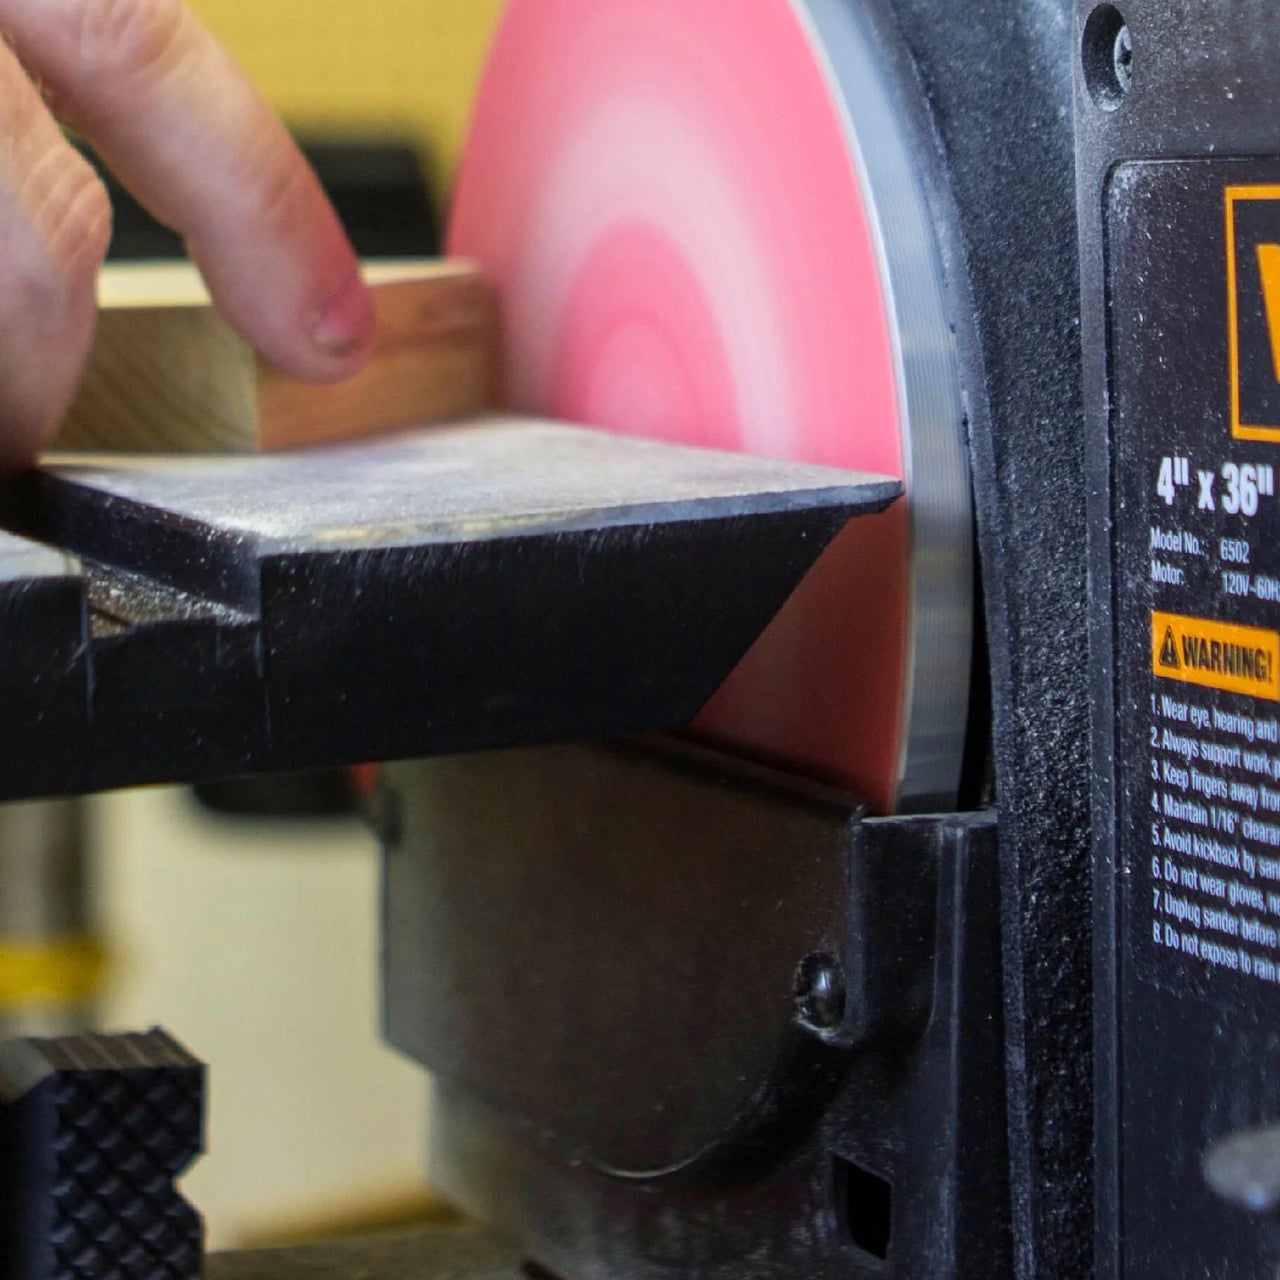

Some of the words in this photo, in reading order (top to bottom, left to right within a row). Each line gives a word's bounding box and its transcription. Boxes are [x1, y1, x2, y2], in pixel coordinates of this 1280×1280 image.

[1156, 456, 1190, 506] 4"
[1221, 461, 1275, 518] 36"
[1150, 525, 1183, 553] Model
[1220, 536, 1251, 565] 6502
[1182, 634, 1273, 685] WARNING!
[1161, 694, 1189, 723] Wear
[1213, 704, 1255, 743] hearing
[1256, 718, 1278, 744] and
[1162, 726, 1199, 761] Always
[1201, 740, 1242, 772] support
[1243, 748, 1272, 777] work
[1162, 760, 1190, 792] Keep
[1191, 769, 1229, 800] fingers
[1230, 783, 1260, 812] away
[1163, 792, 1209, 827] Maintain
[1164, 828, 1192, 857] Avoid
[1193, 834, 1240, 870] kickback
[1243, 850, 1257, 880] by
[1164, 858, 1179, 884] Do
[1181, 867, 1198, 891] not
[1200, 874, 1227, 900] wear
[1164, 890, 1201, 928] Unplug
[1202, 905, 1239, 936] sander
[1241, 916, 1277, 948] before
[1164, 923, 1180, 950] Do
[1181, 933, 1199, 958] not
[1200, 940, 1239, 973] expose
[1240, 951, 1252, 975] to
[1253, 957, 1277, 984] rain
